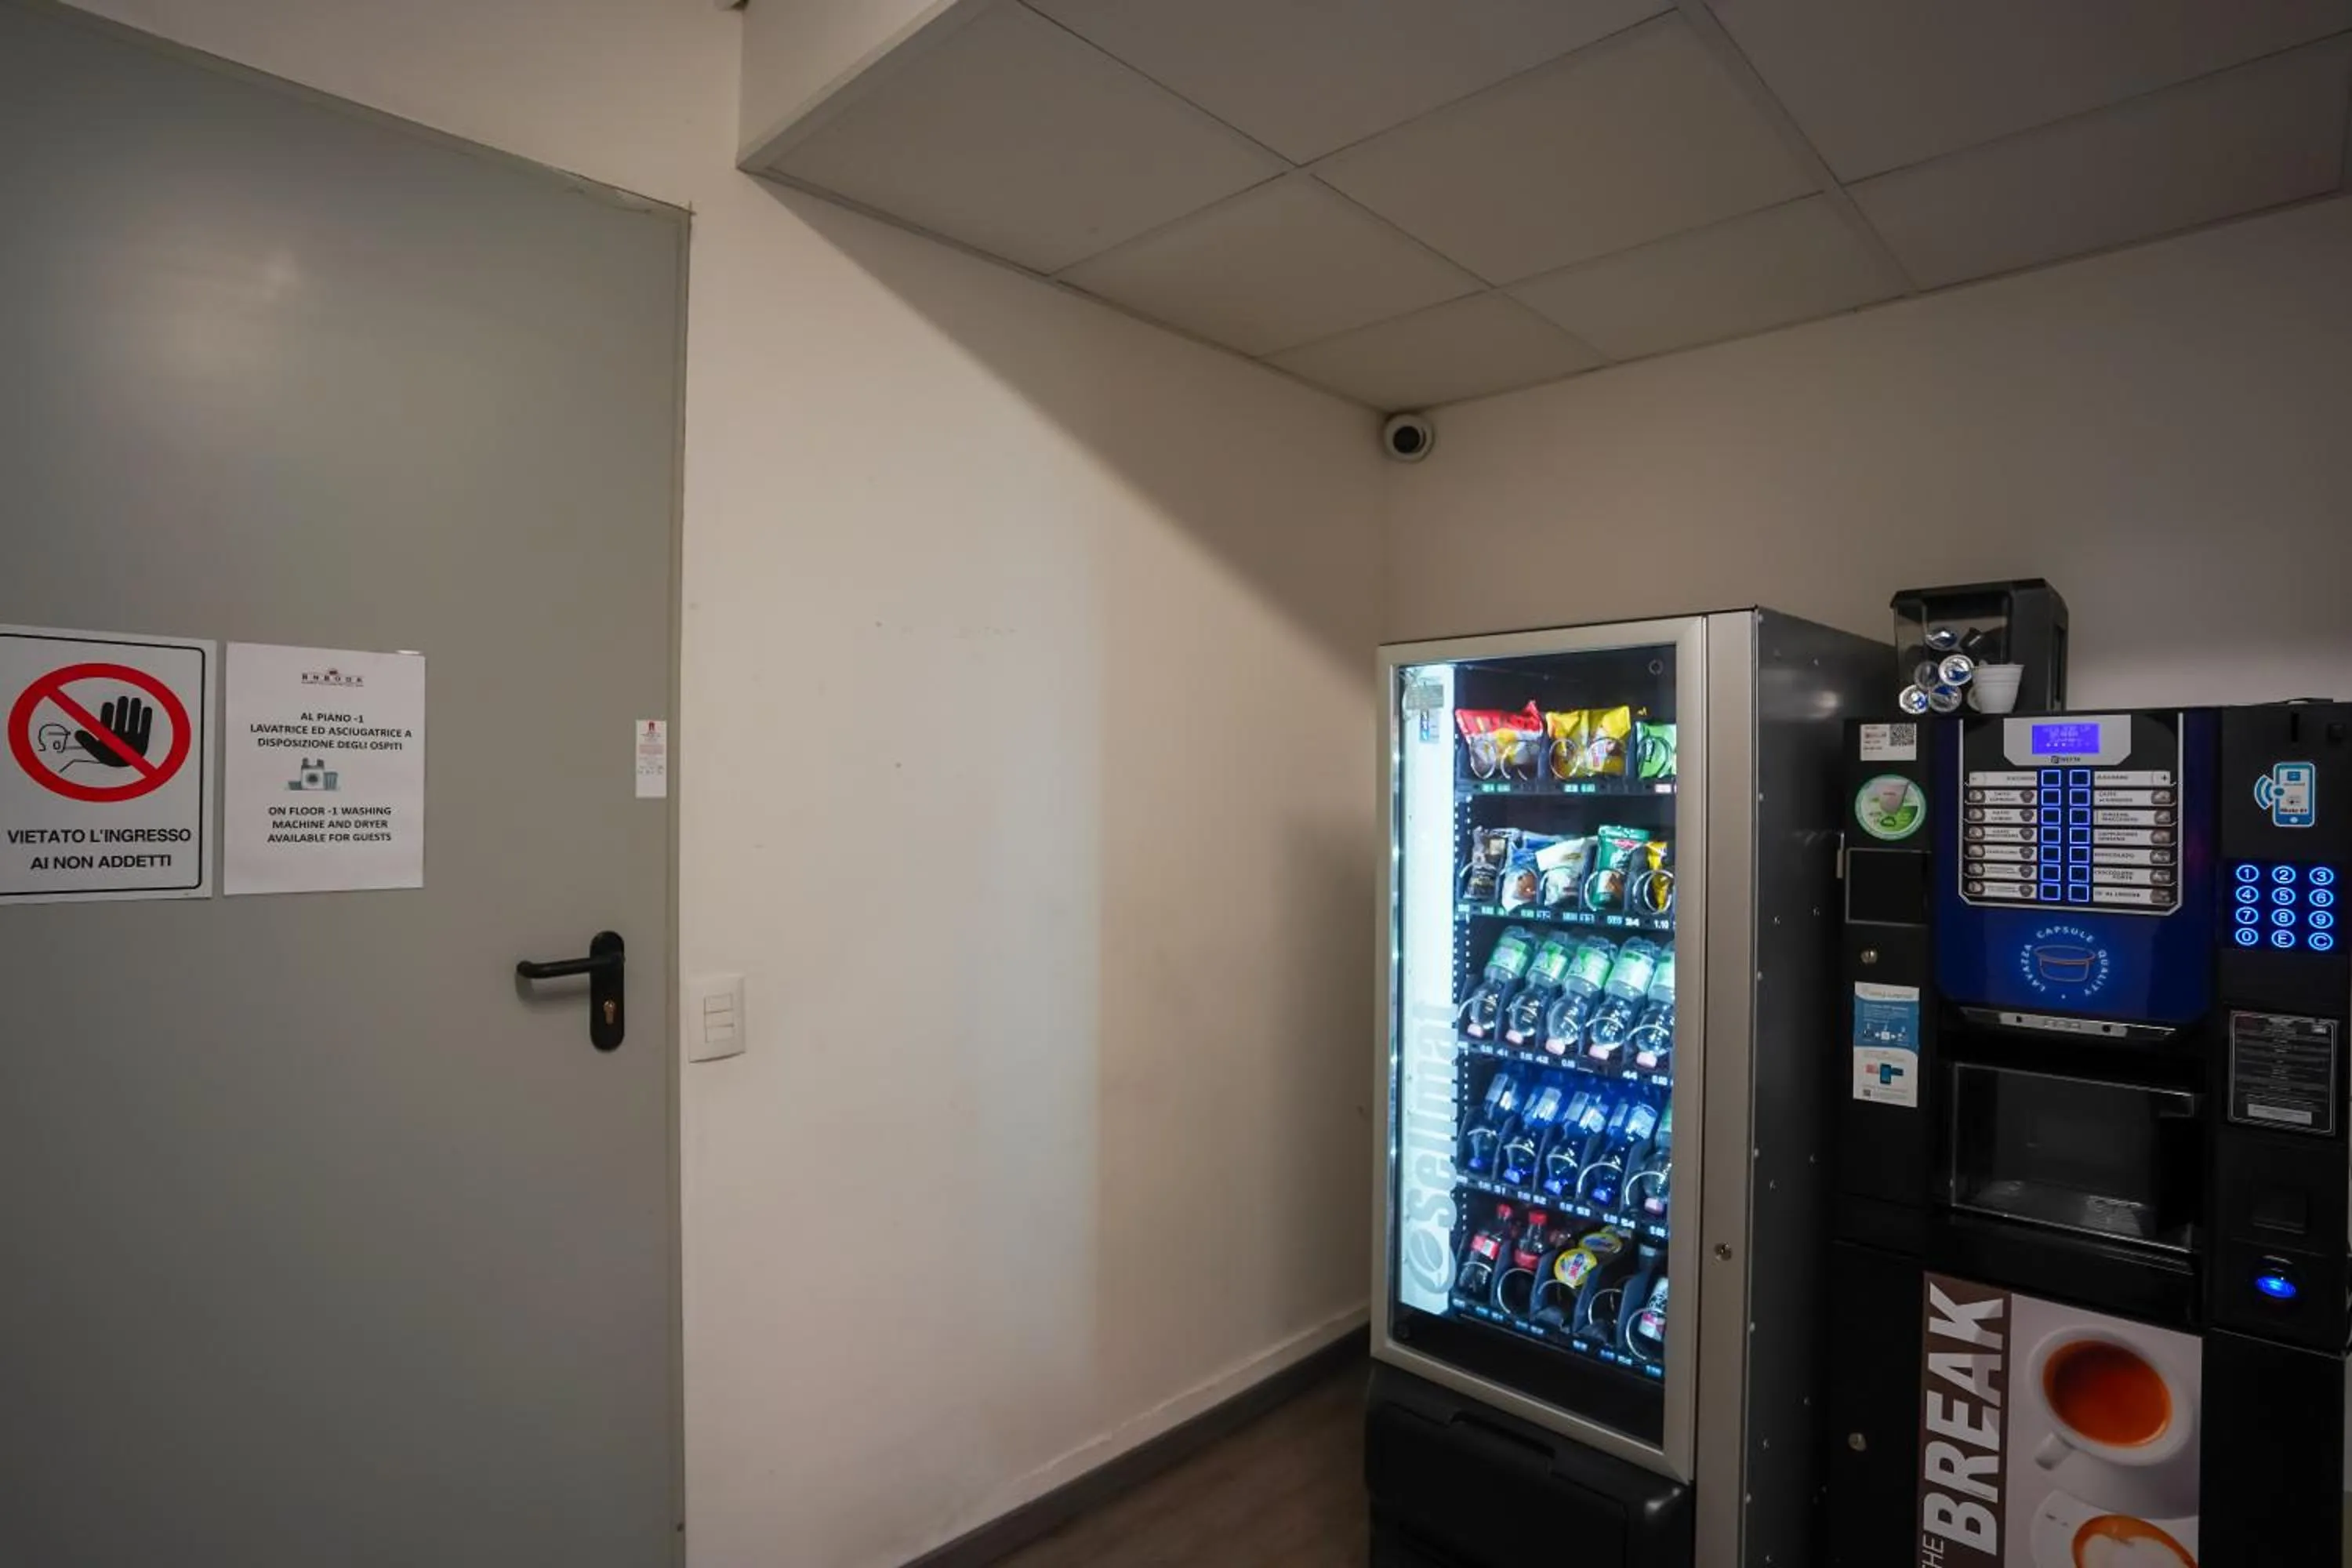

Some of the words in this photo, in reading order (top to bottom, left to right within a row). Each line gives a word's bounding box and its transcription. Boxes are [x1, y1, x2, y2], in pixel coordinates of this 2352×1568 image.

[300, 712, 314, 722] AL
[317, 713, 351, 723] PIANO
[353, 714, 364, 724] -1
[250, 724, 308, 735] LAVATRICE
[311, 726, 325, 735] ED
[328, 727, 401, 738] ASCIUGATRICE
[404, 729, 412, 739] A
[257, 738, 335, 750] DISPOSIZIONE
[337, 740, 368, 750] DEGLI
[369, 741, 402, 751] OSPITI
[267, 807, 286, 816] ON
[289, 807, 325, 816] FLOOR
[327, 807, 338, 816] -1
[341, 806, 392, 816] WASHING
[272, 819, 325, 829] MACHINE
[328, 819, 352, 829] AND
[354, 819, 388, 829] DRYER
[7, 828, 85, 844] VIETATO
[89, 827, 191, 843] L'INGRESSO
[267, 833, 326, 843] AVAILABLE
[328, 833, 350, 843] FOR
[353, 832, 392, 842] GUESTS
[30, 855, 49, 870] AI
[53, 855, 94, 869] NON
[98, 853, 172, 869] ADDETTI
[2243, 868, 2250, 879] 1
[2278, 869, 2288, 880] 2
[2316, 871, 2326, 882] 3
[2241, 889, 2251, 899] 4
[2279, 890, 2288, 901] 5
[2316, 892, 2326, 904] 6
[2243, 910, 2251, 921] 7
[2279, 912, 2288, 923] 8
[2315, 913, 2326, 925] 9
[2241, 931, 2252, 942] 0
[2278, 933, 2288, 945] E
[2313, 935, 2328, 947] C
[2020, 944, 2046, 993] LAVAZZA
[2035, 925, 2095, 943] CAPSULE
[2083, 949, 2109, 997] QUALITY
[1923, 1280, 2004, 1556] BREAK
